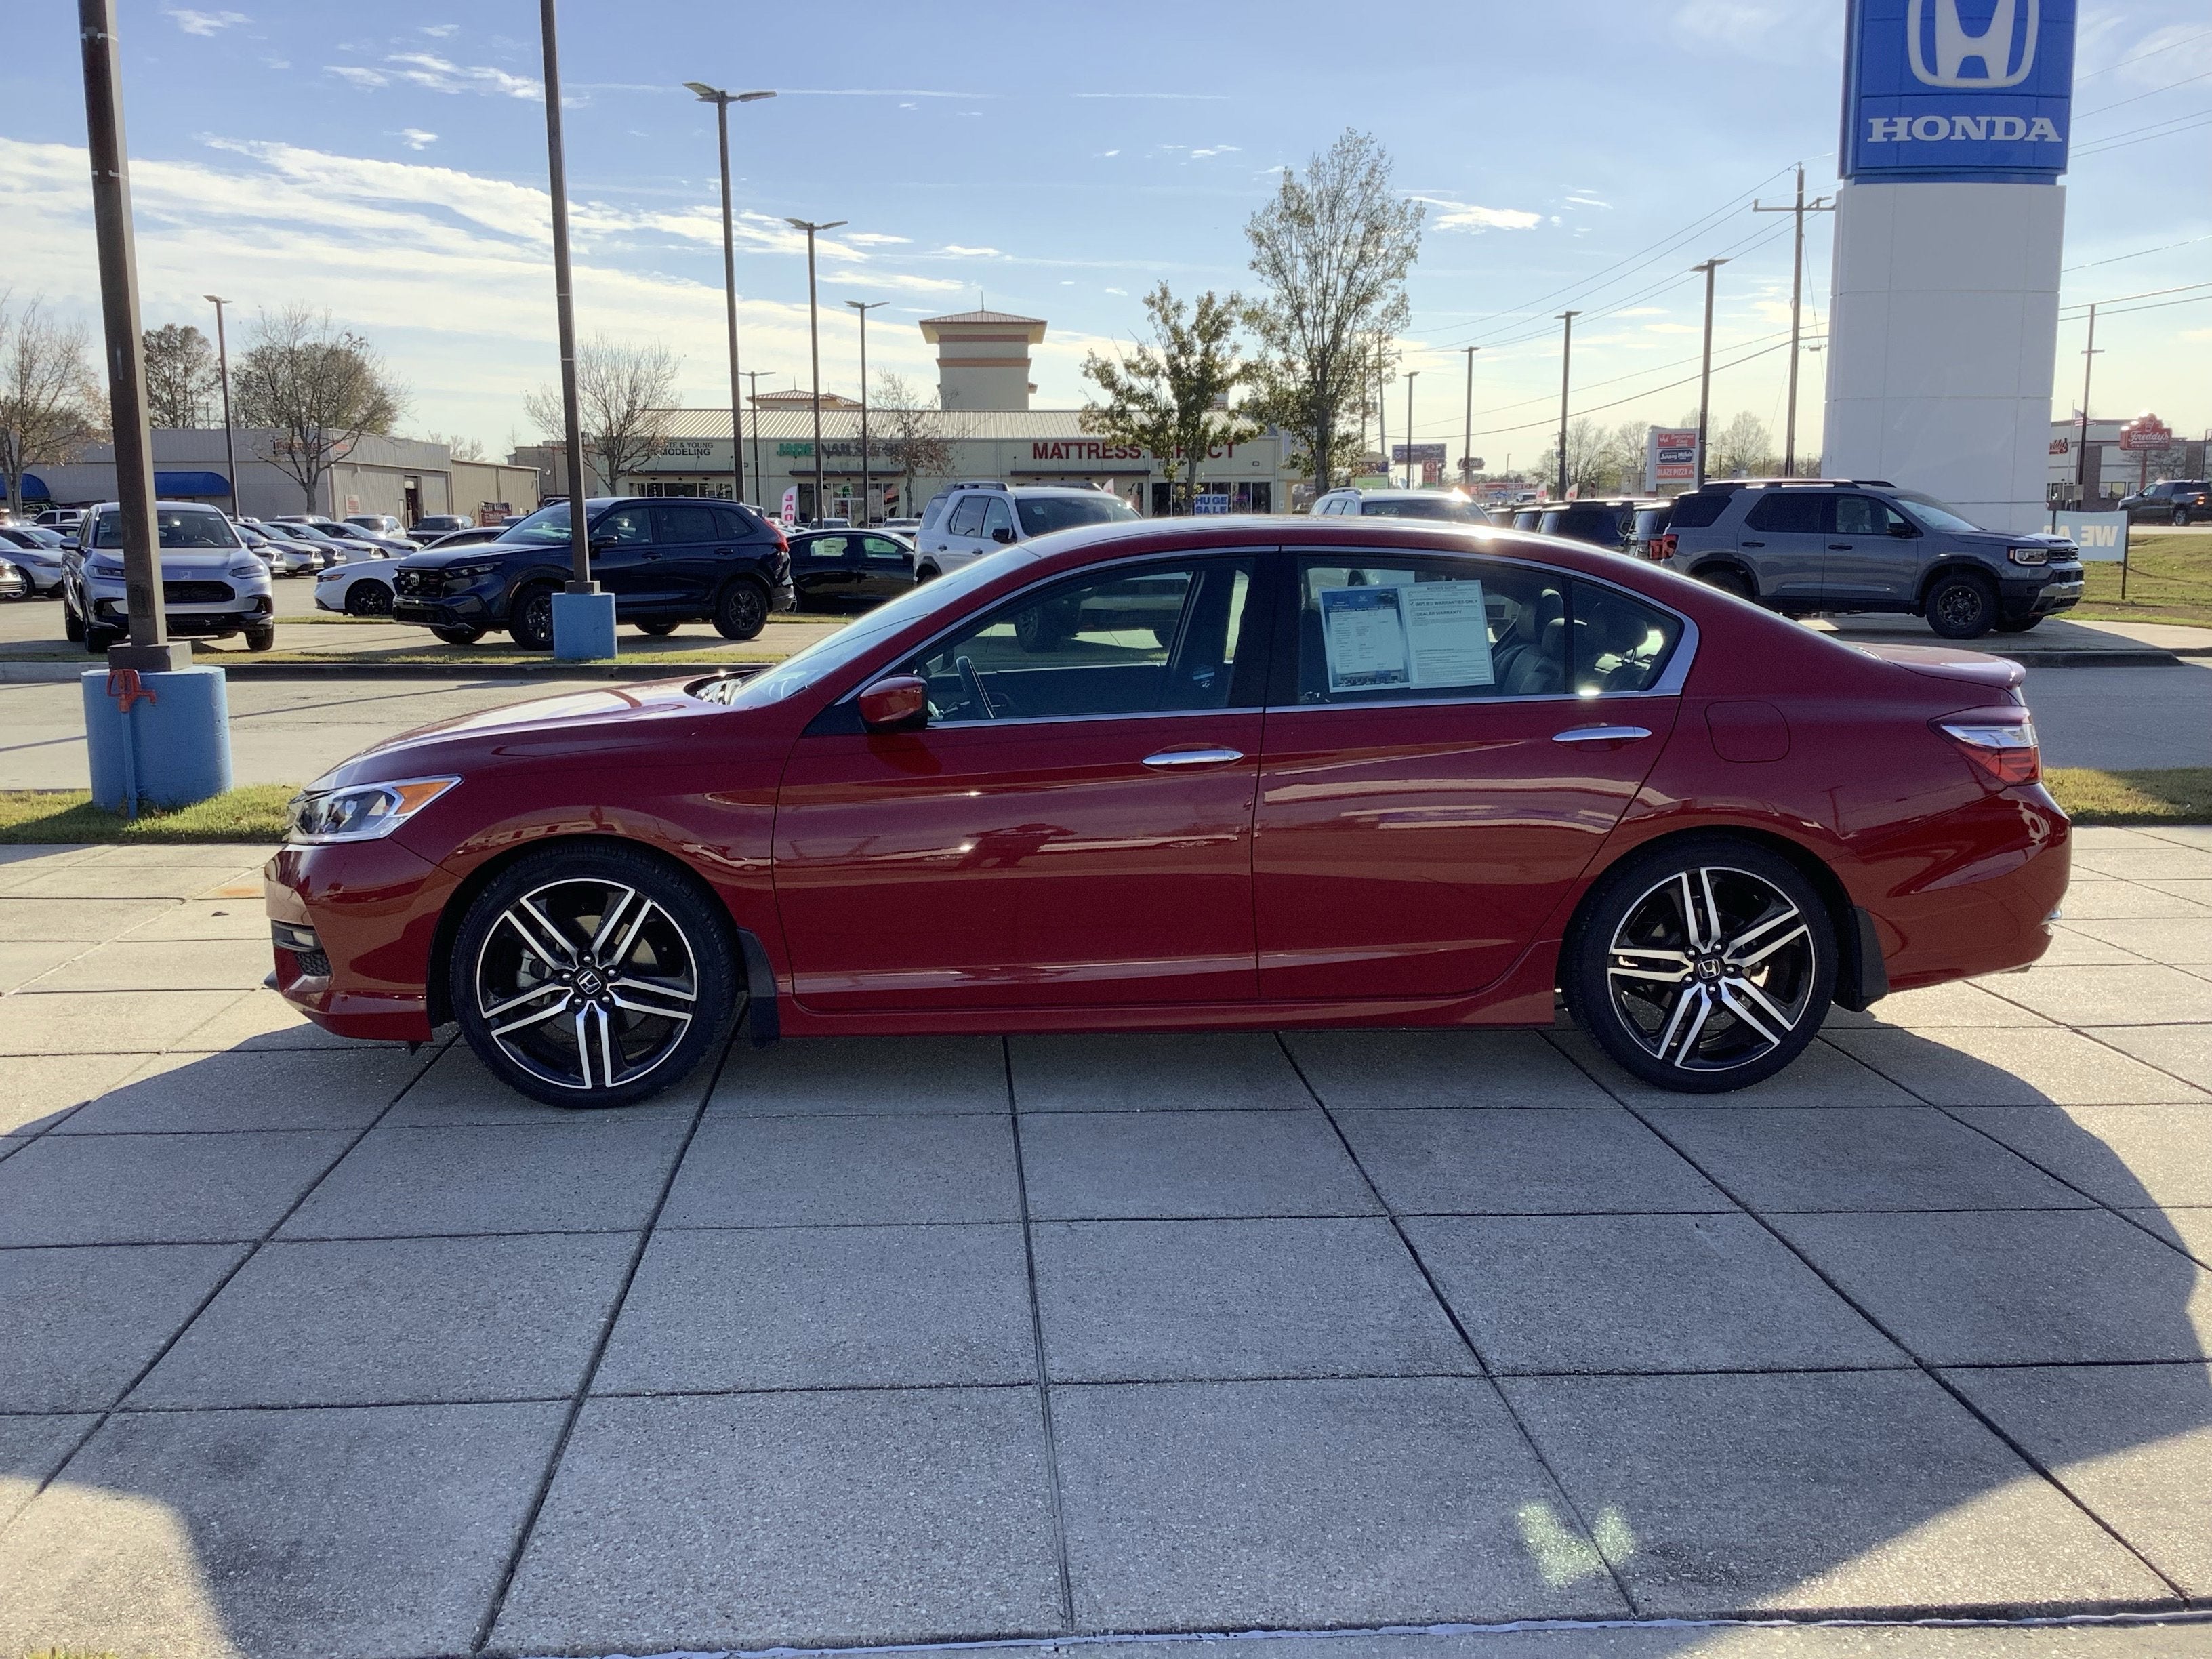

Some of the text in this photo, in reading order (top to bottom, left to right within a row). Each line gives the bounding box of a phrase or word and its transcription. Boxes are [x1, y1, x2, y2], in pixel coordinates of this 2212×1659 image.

[1867, 115, 2063, 142] HONDA
[2129, 431, 2169, 442] Freddy's
[777, 443, 816, 456] JADE
[1033, 442, 1141, 459] MATTRESS
[1195, 506, 1227, 514] SALE
